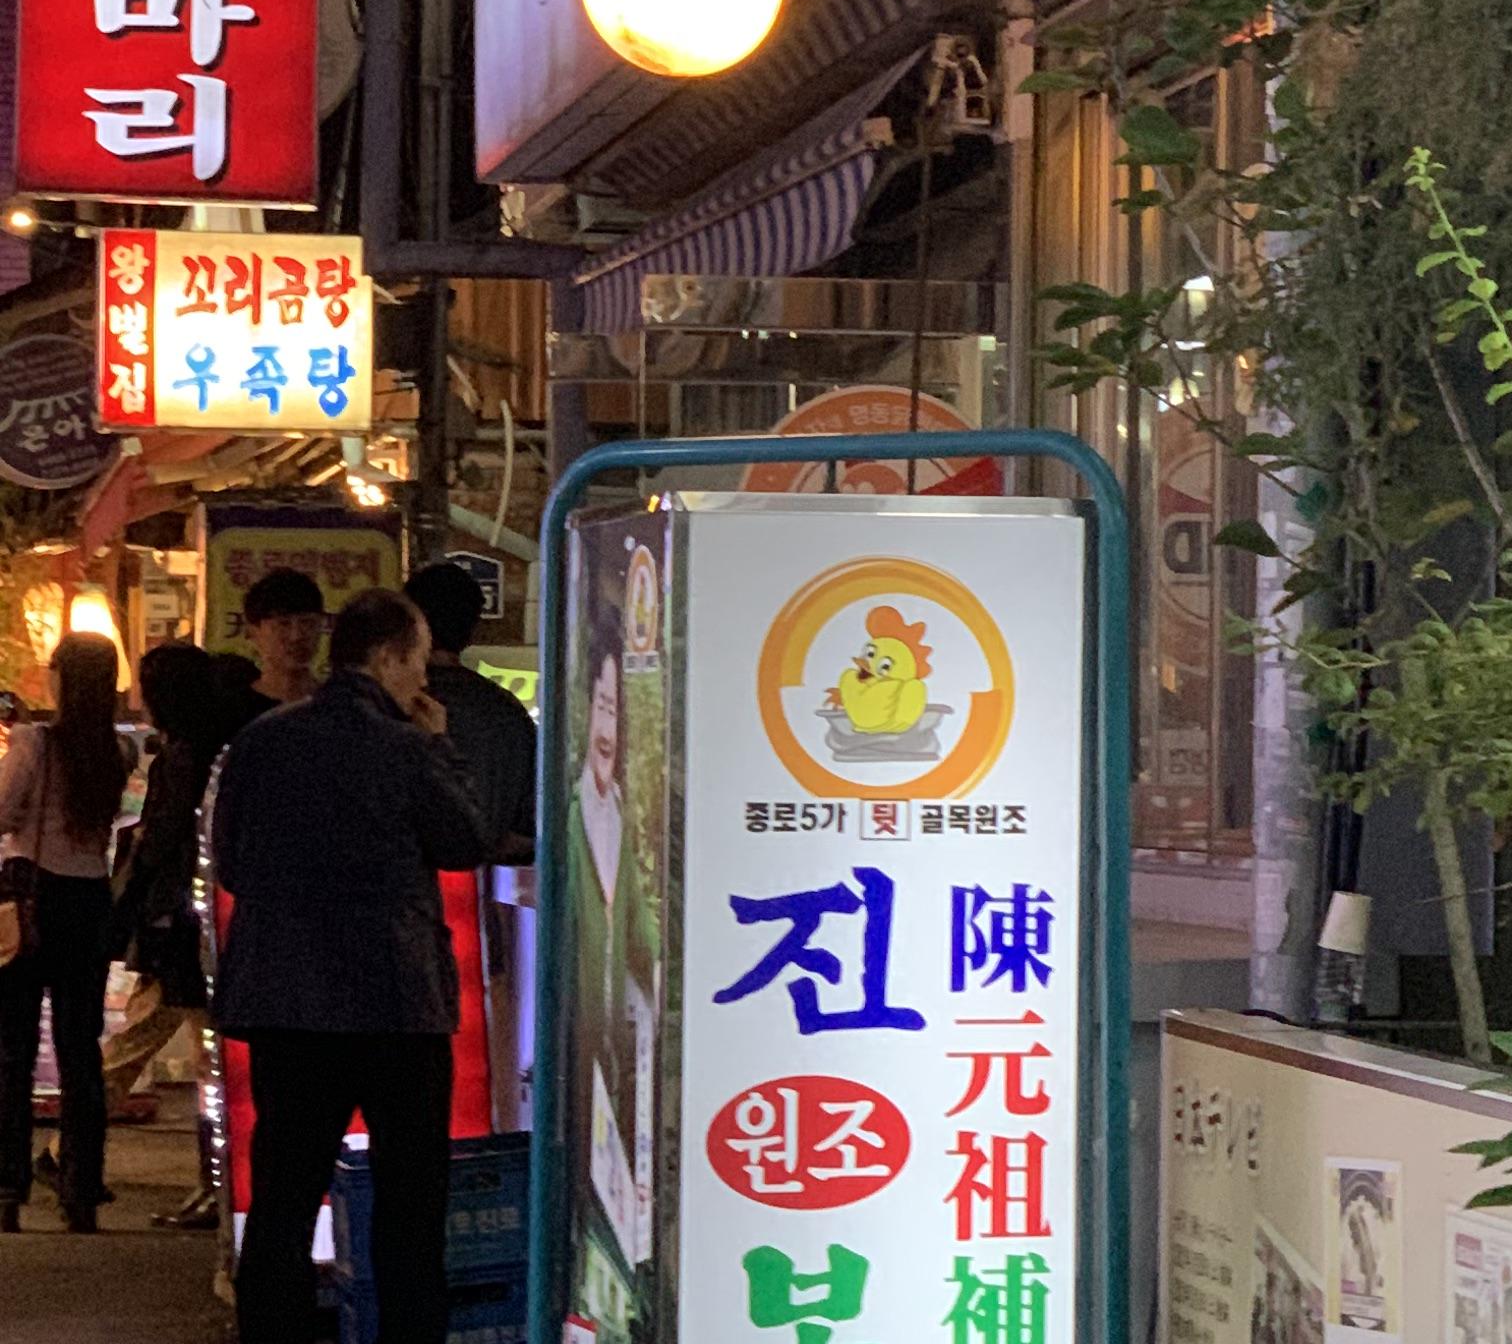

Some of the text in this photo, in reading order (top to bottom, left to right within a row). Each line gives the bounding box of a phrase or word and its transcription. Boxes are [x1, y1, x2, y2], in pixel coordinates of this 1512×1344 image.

[176, 251, 360, 330] 꼬리곰탕
[172, 343, 357, 418] 우족탕
[745, 801, 848, 834] 종로5가
[920, 803, 1028, 836] 골목원조
[712, 866, 928, 1035] 진
[726, 1087, 891, 1194] 원조
